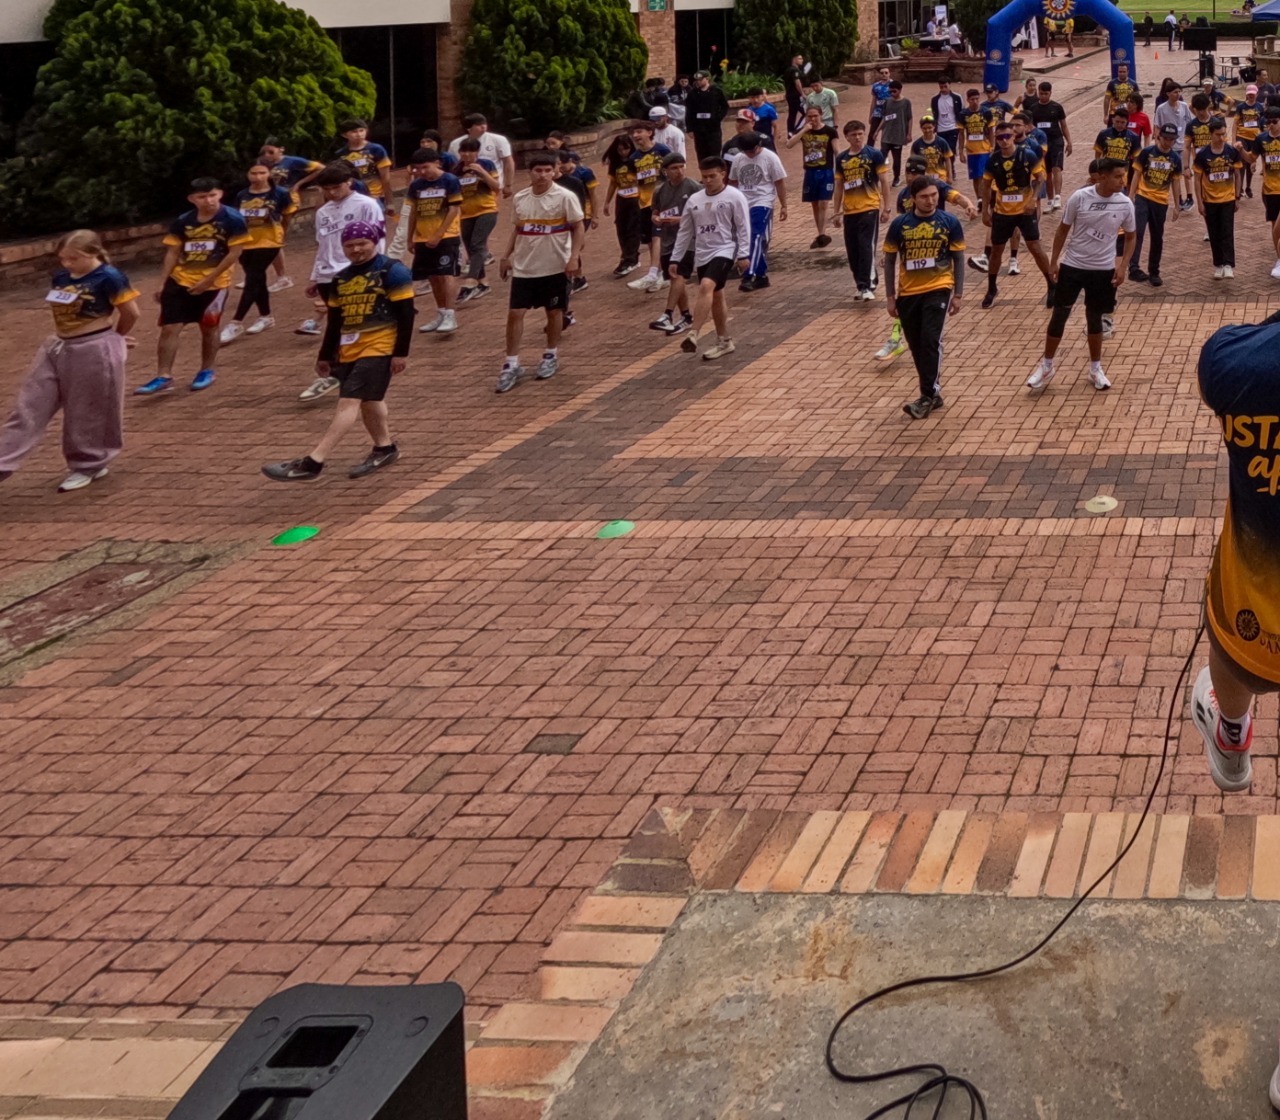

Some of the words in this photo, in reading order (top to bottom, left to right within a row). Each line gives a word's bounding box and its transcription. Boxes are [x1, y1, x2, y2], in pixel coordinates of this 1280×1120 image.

[529, 224, 546, 233] 251
[700, 224, 716, 234] 249
[190, 242, 207, 251] 196
[906, 240, 942, 249] SANTOTO
[906, 248, 940, 259] CORRE
[913, 259, 927, 270] 119
[341, 303, 376, 317] RRE
